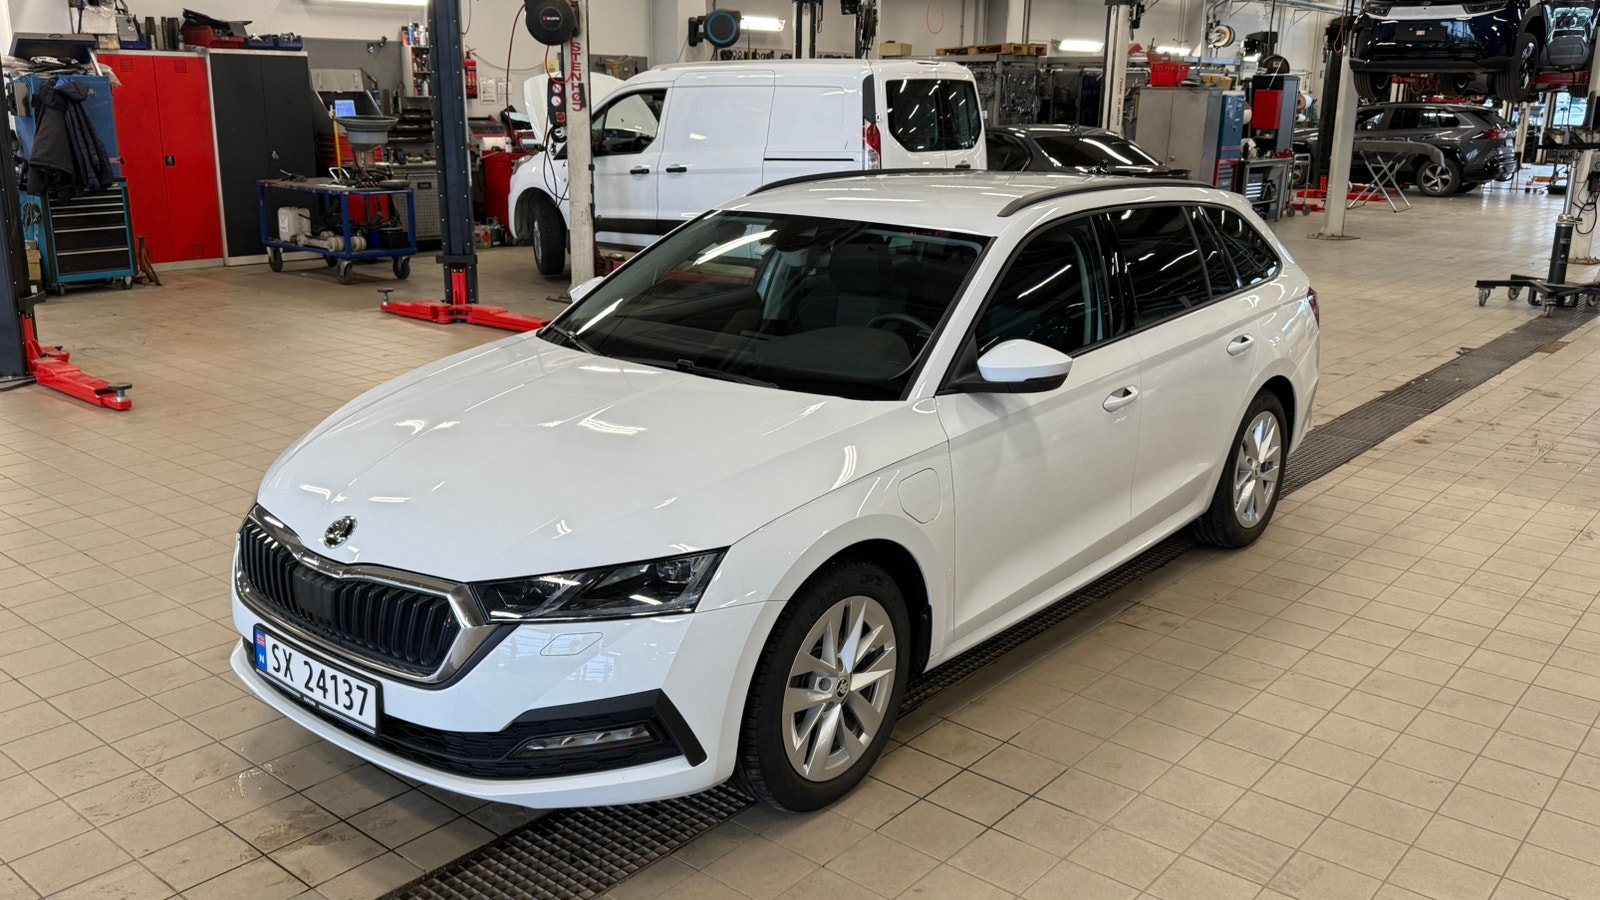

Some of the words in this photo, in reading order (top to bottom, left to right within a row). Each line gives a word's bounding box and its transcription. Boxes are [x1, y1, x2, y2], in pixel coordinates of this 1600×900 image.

[259, 653, 265, 664] N
[272, 643, 294, 682] SX
[303, 660, 368, 716] 24137
